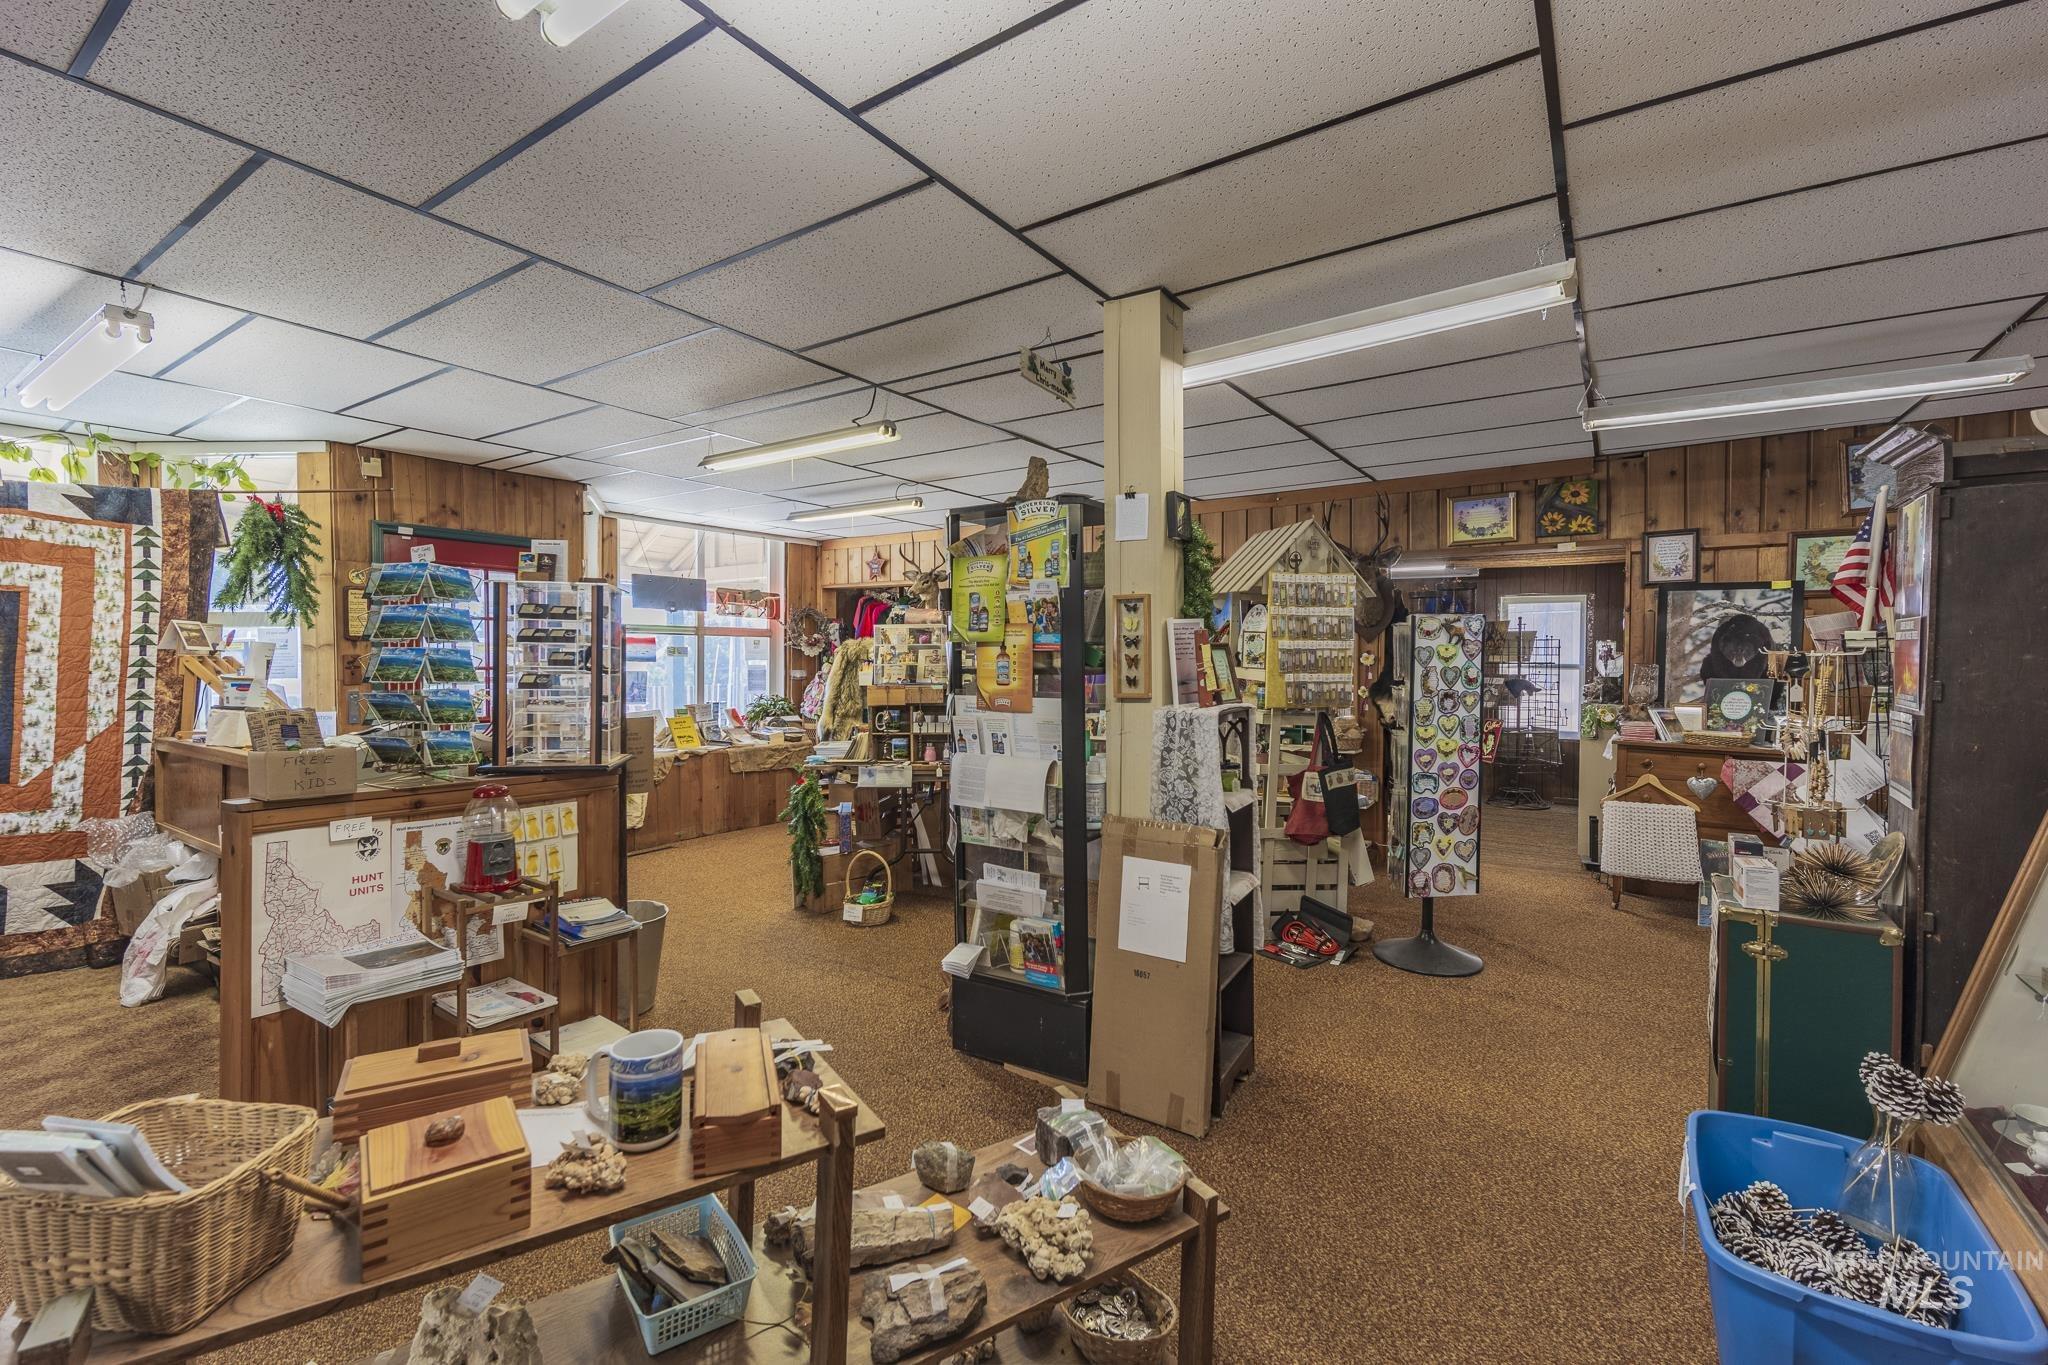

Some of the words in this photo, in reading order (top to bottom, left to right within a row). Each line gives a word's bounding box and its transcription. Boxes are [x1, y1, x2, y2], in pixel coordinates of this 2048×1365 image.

[1039, 359, 1057, 379] Merry
[1018, 500, 1056, 510] SOVEREIGN
[1020, 506, 1056, 516] SILVER
[283, 755, 336, 768] FREE
[304, 767, 317, 775] for
[294, 777, 337, 791] KIDS
[335, 821, 366, 833] FREE
[351, 871, 384, 884] HUNT
[349, 883, 385, 897] UNITS
